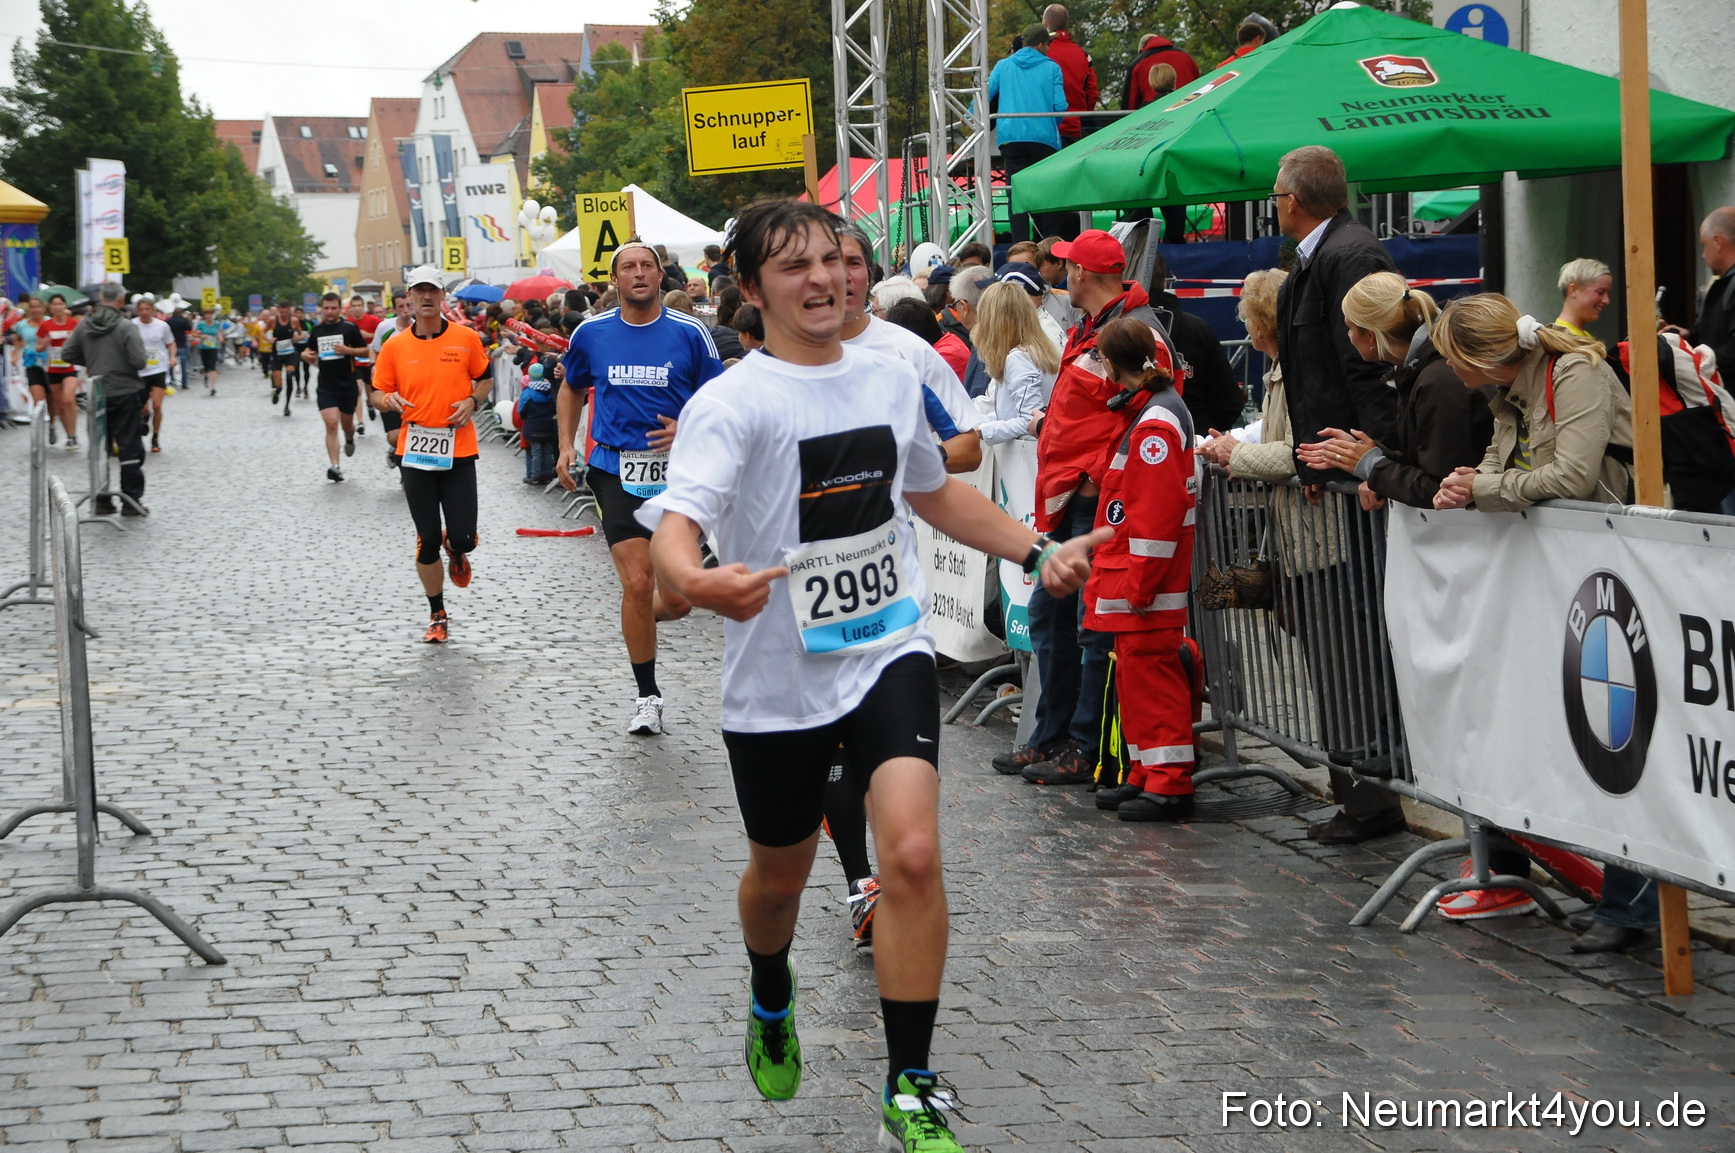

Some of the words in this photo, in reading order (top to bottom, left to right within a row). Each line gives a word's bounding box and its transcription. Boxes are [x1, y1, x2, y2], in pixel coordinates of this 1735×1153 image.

[1340, 92, 1506, 112] Neumarkter
[693, 109, 801, 128] Schnupper-
[1316, 105, 1552, 132] Lammsbräu
[732, 131, 766, 149] lauf
[583, 196, 628, 213] Block
[593, 220, 621, 263] A
[110, 248, 122, 265] B
[449, 249, 461, 265] B
[608, 365, 669, 380] HUBER
[410, 435, 449, 455] 2220
[624, 461, 668, 482] 2765
[636, 487, 662, 496] Günter
[790, 556, 833, 574] PARTL
[835, 540, 887, 564] Neumarkt
[933, 548, 947, 572] der
[948, 550, 966, 578] Stadt
[805, 553, 898, 621] 2993
[932, 592, 955, 620] 92318
[1568, 577, 1647, 653] BMW
[841, 619, 887, 643] Lucas
